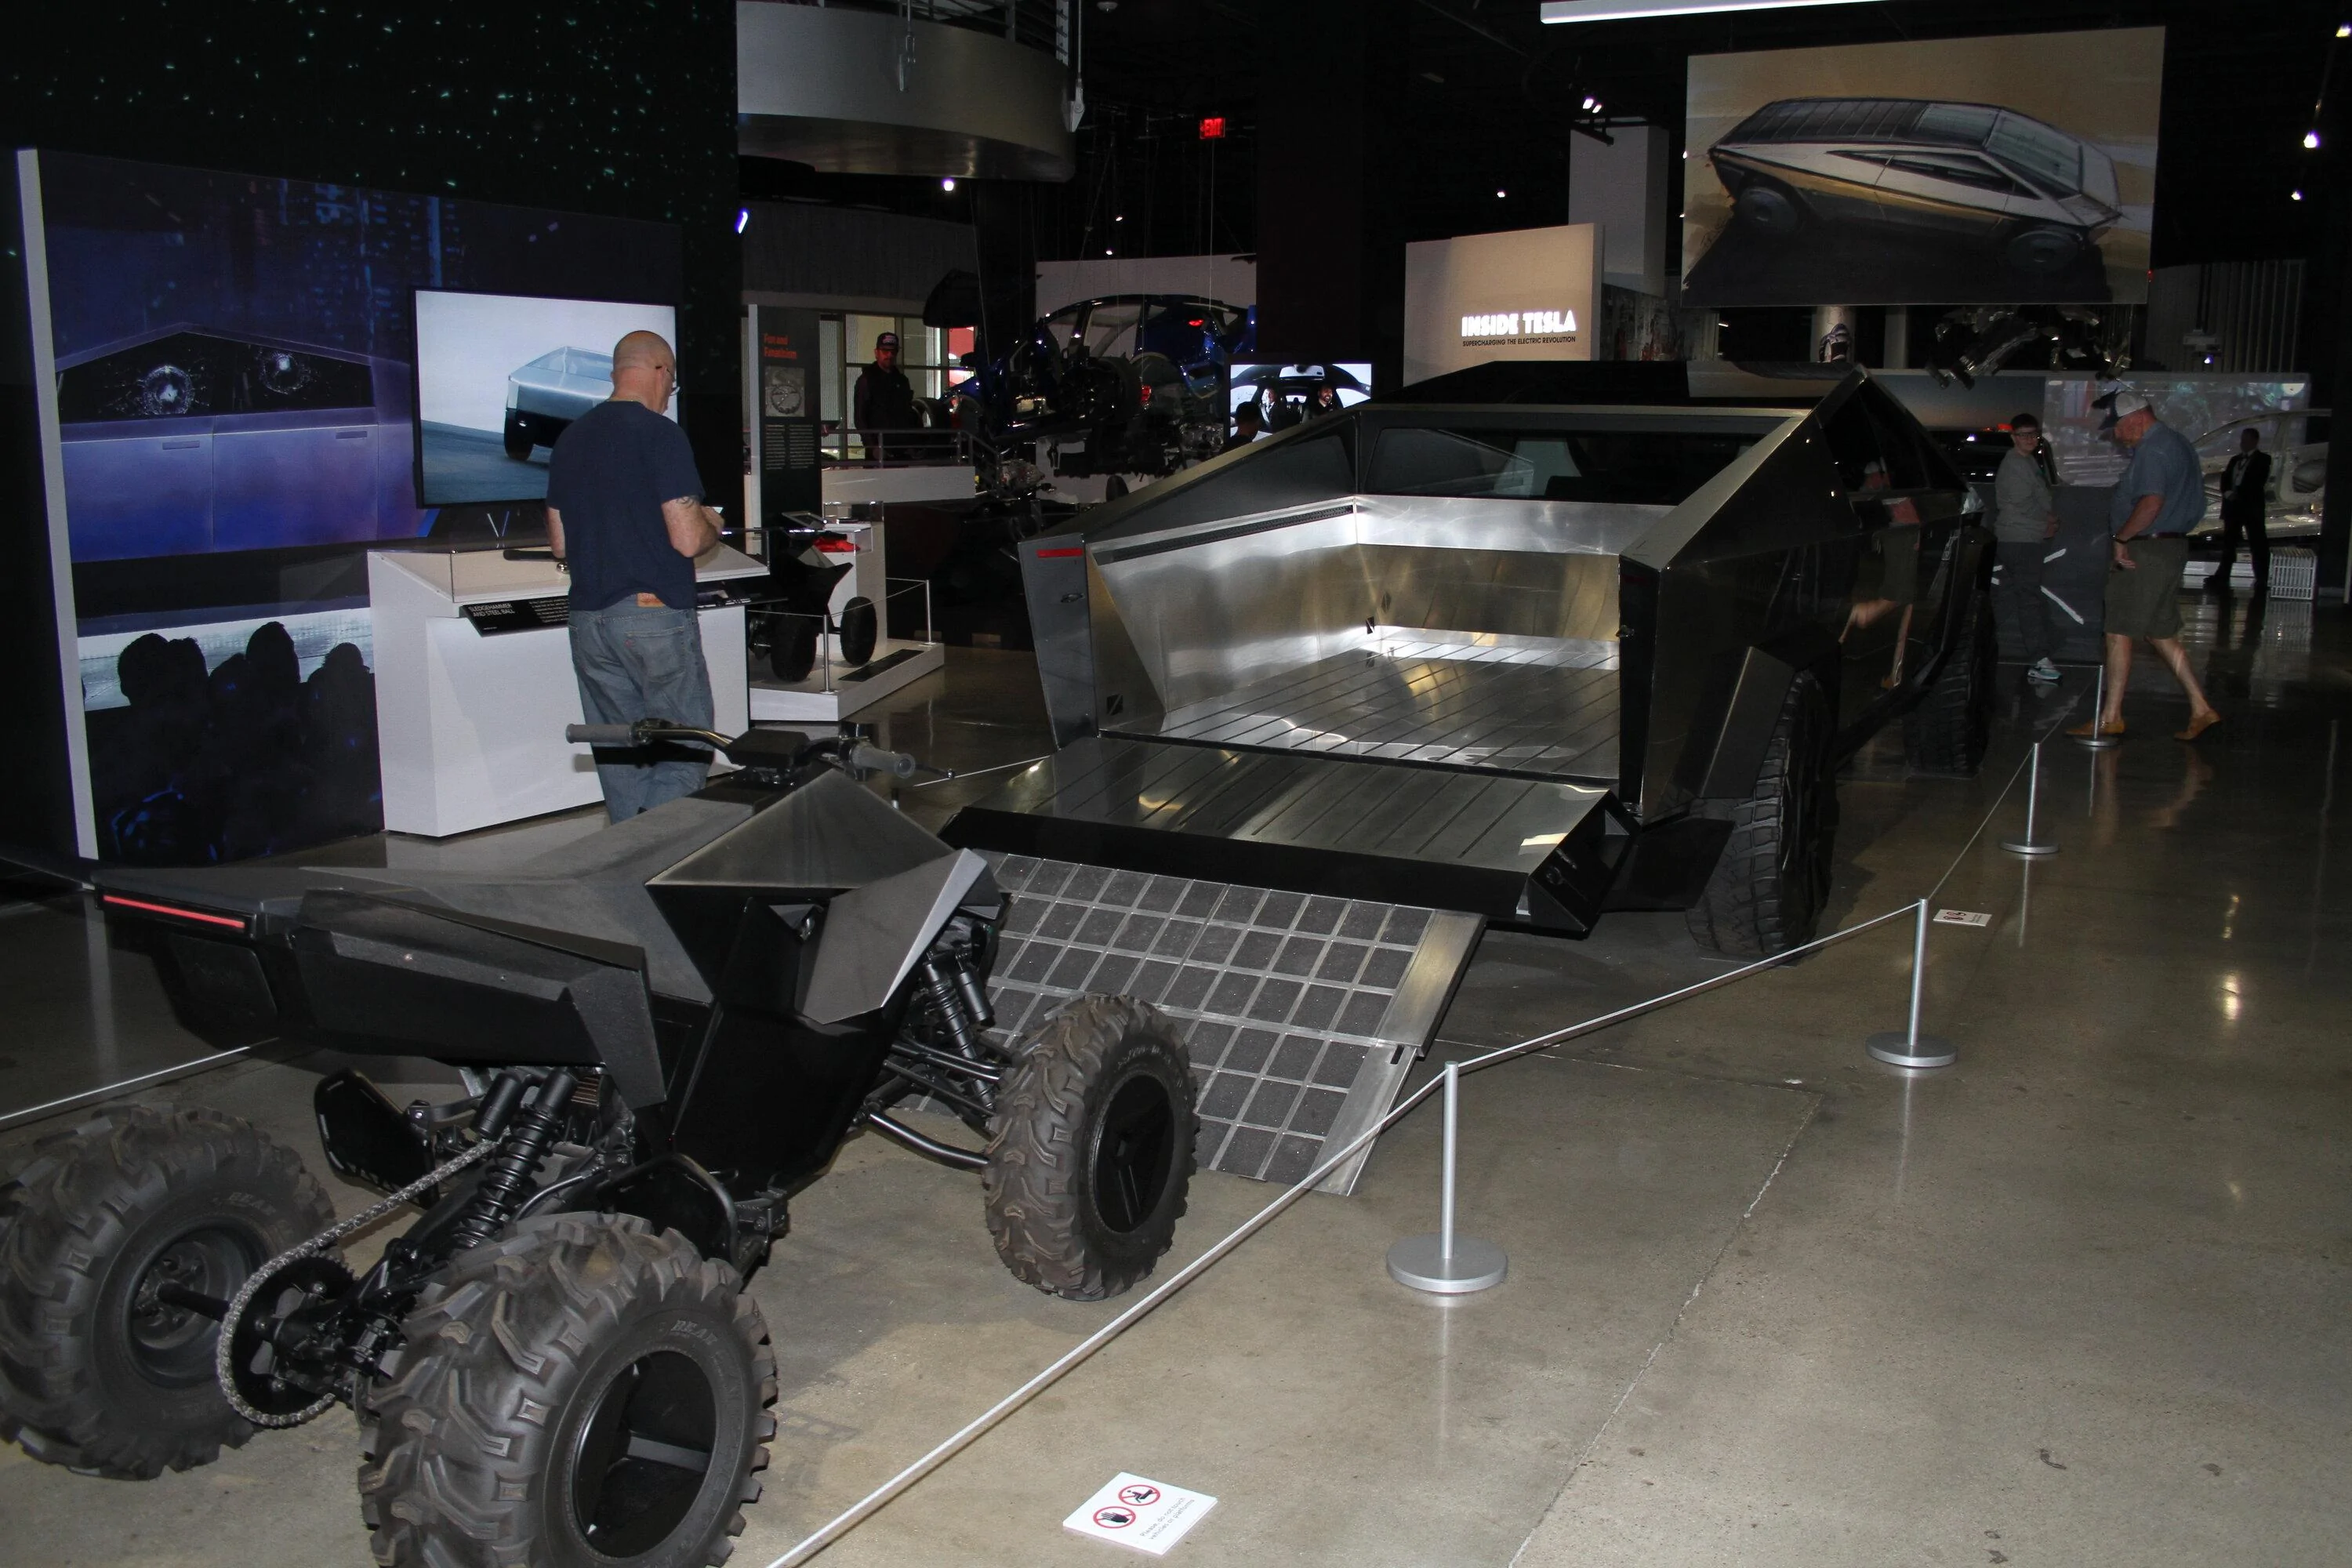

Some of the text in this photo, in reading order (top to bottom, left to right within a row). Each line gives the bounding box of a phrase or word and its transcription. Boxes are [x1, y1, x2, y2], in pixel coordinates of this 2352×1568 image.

[1203, 118, 1222, 136] EXIT
[1461, 309, 1577, 337] INSIDE TESLA
[1462, 338, 1506, 347] SUPERCHARGING
[1517, 336, 1542, 345] ELECTRIC
[1542, 335, 1577, 344] REVOLUTION
[468, 603, 513, 612] SLEDGEHAMMER
[473, 609, 486, 618] AND
[485, 608, 502, 617] STEEL
